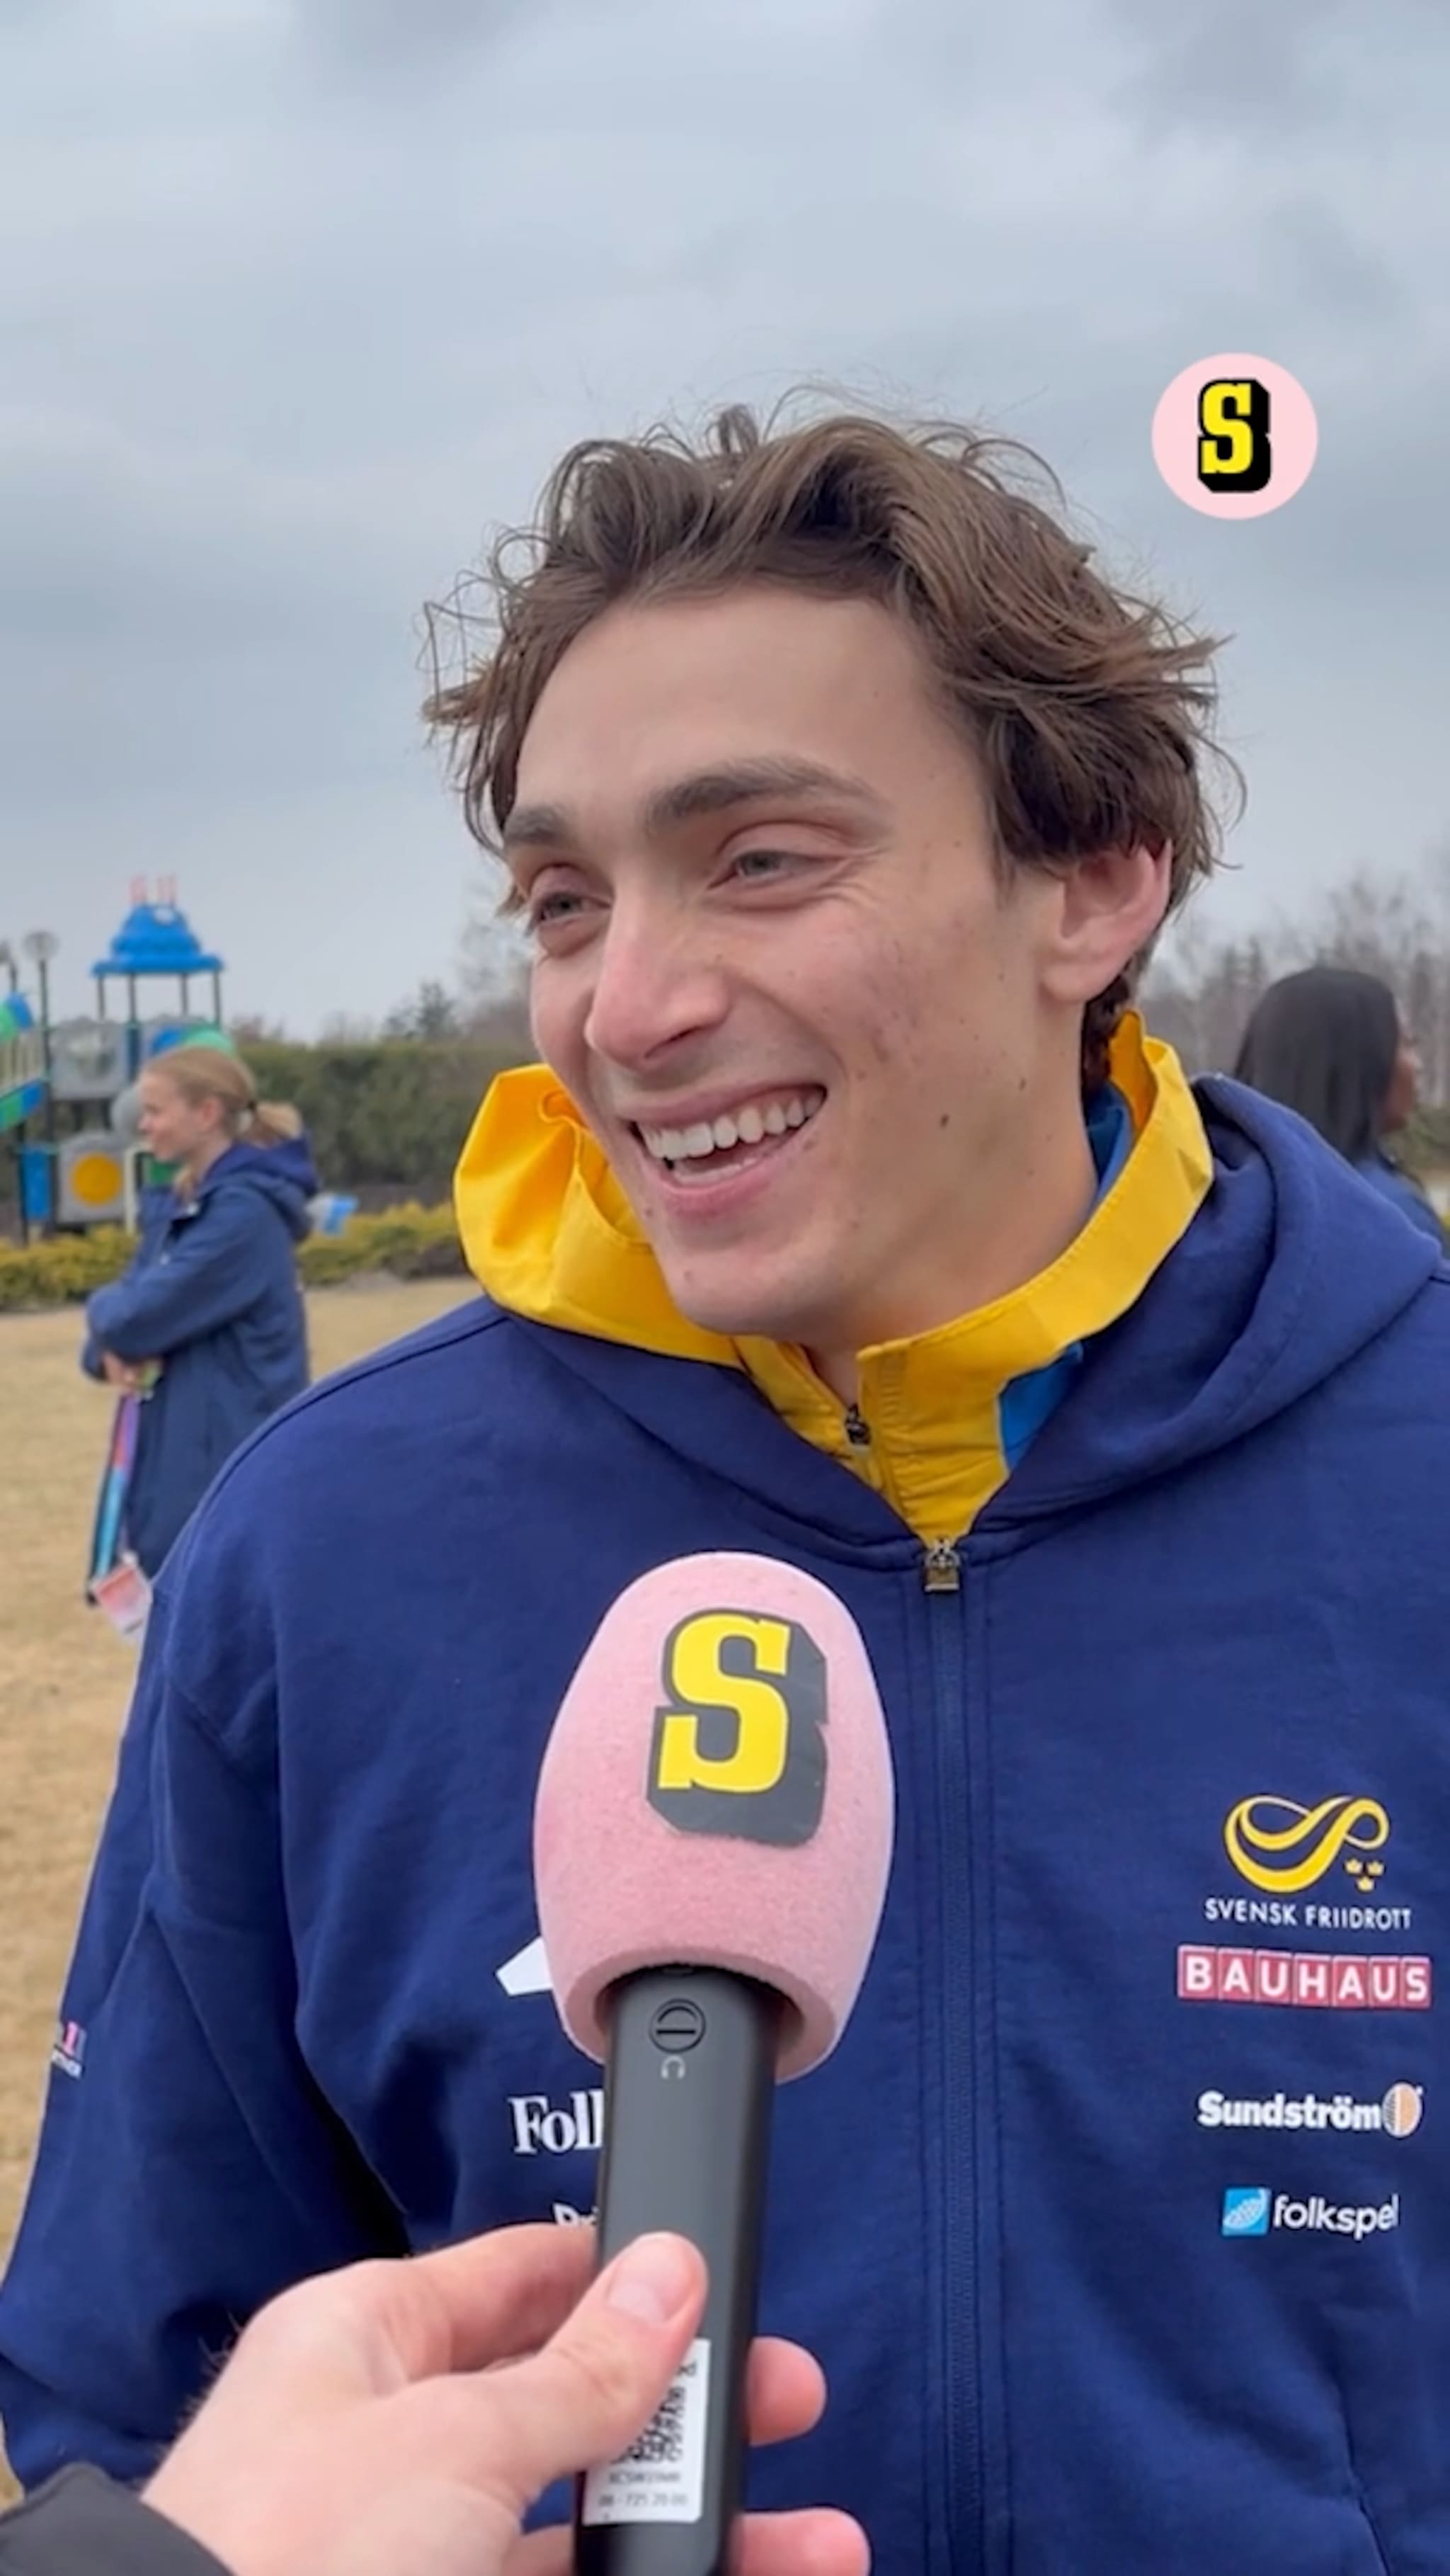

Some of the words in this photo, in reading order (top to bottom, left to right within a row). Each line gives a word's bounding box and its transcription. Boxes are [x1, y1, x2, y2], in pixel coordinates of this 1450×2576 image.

[656, 1611, 792, 1795] S
[1204, 1898, 1298, 1927] SVENSK
[1305, 1905, 1412, 1930] FRIIDROTT
[1185, 1955, 1428, 2002] BAUHAUS
[1197, 2090, 1382, 2131] Sundström
[1274, 2194, 1400, 2241] folkspel
